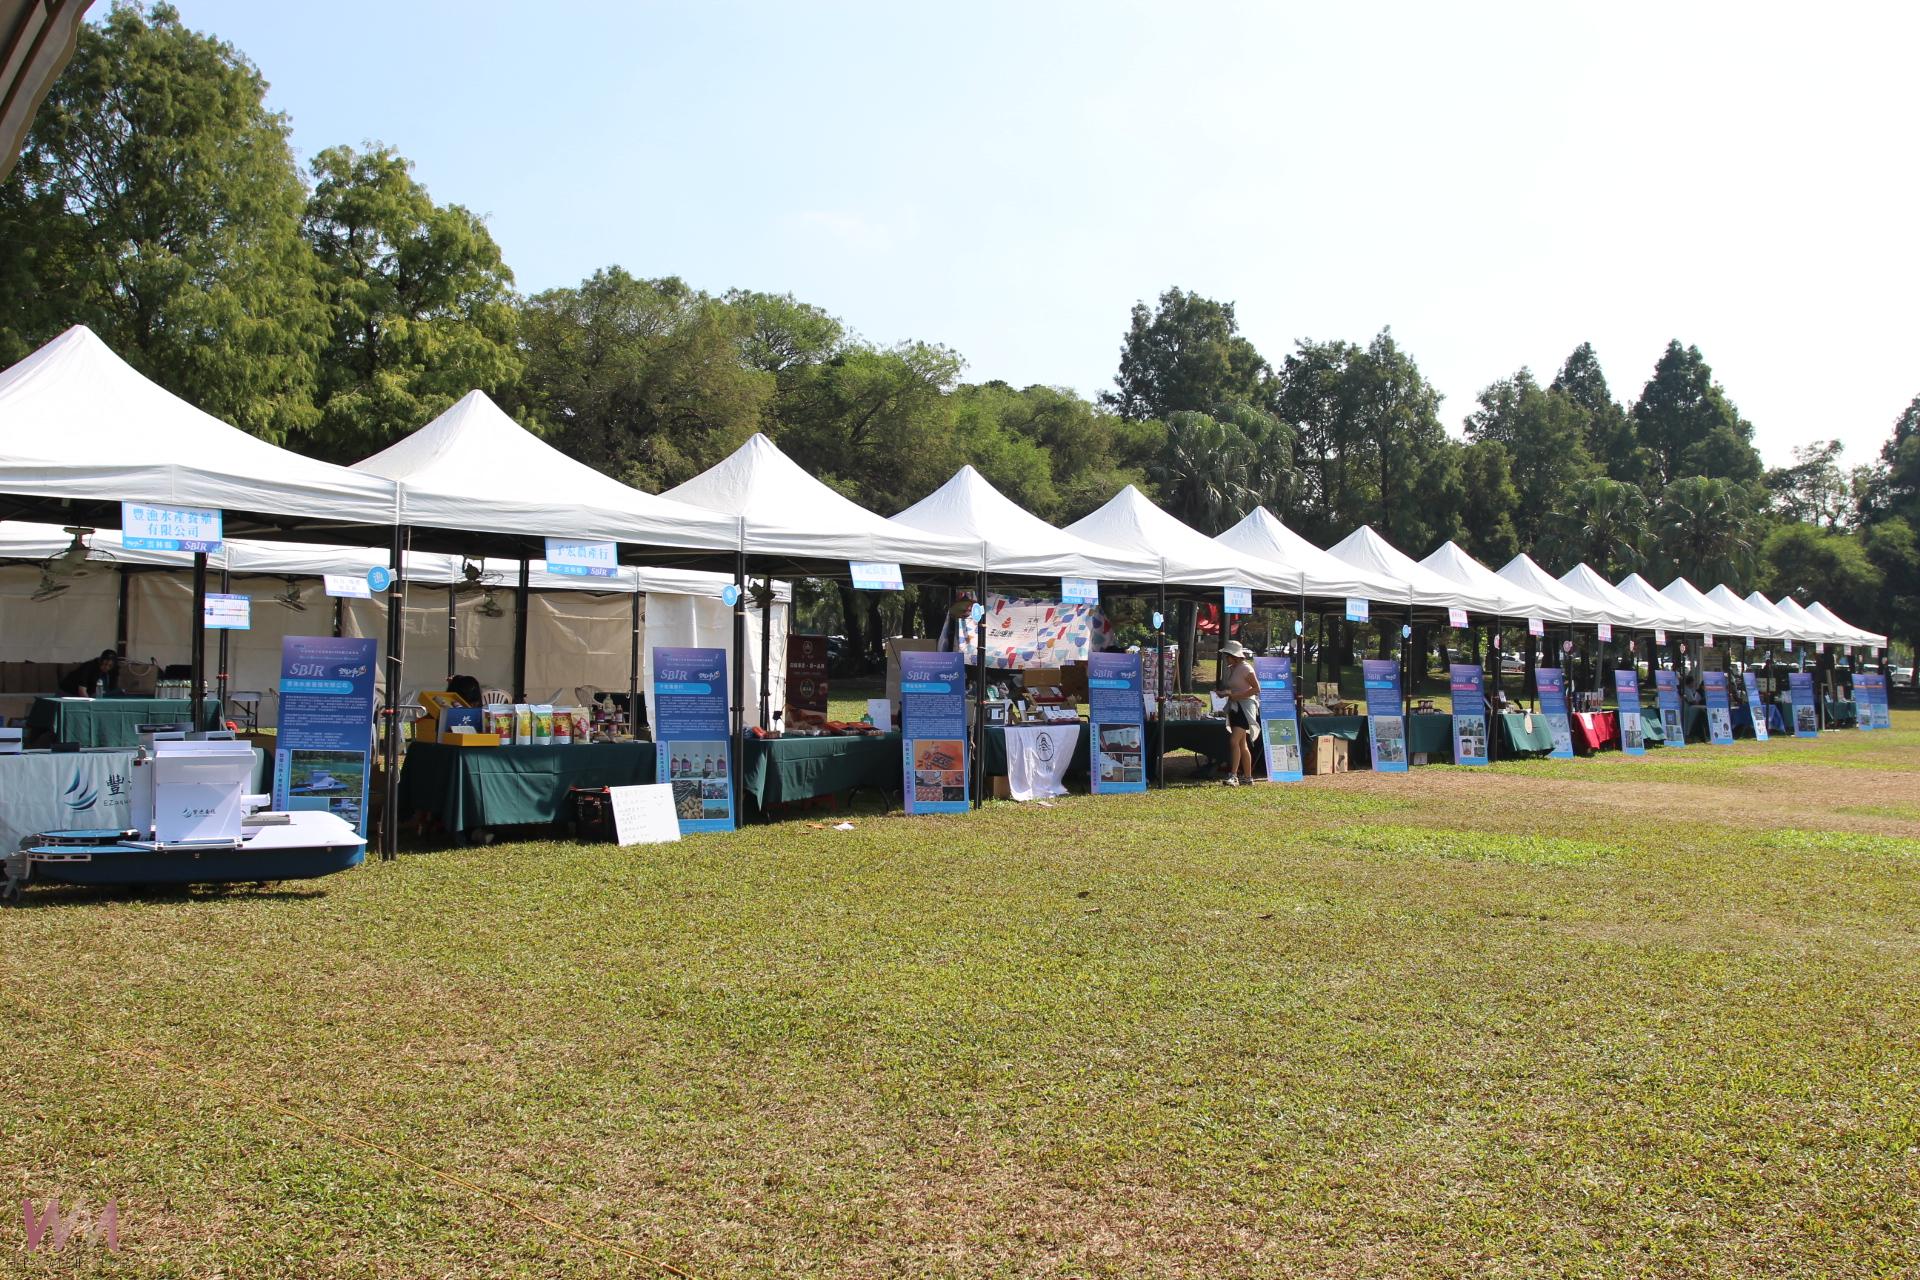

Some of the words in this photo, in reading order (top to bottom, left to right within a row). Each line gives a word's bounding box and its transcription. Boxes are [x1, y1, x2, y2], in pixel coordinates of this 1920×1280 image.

[148, 523, 200, 538] 有限公司
[184, 540, 208, 552] SBIR
[289, 663, 325, 677] SBIR
[660, 669, 688, 681] SBIR
[906, 670, 931, 681] SBIR
